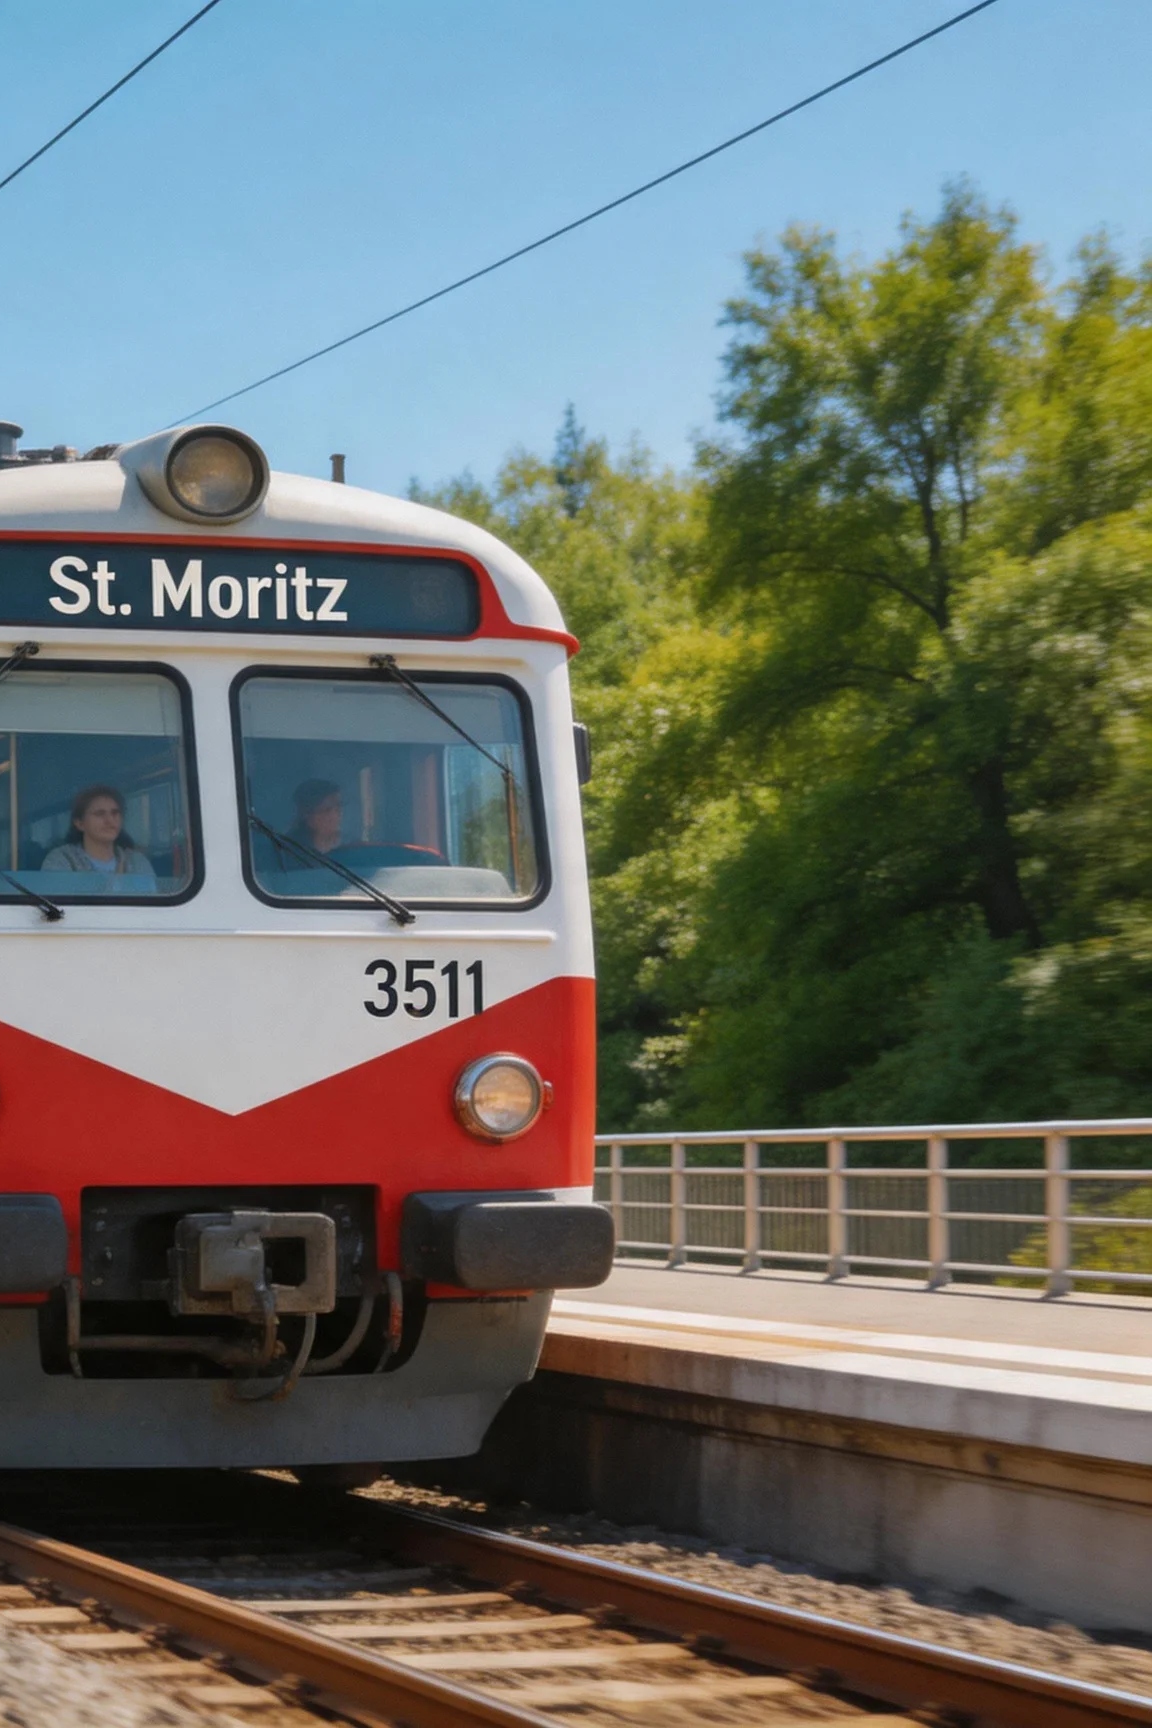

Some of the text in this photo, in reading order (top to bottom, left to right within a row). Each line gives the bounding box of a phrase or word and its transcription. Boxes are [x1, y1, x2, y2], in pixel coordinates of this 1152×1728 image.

[48, 555, 348, 622] St. Moritz
[363, 958, 484, 1018] 3511
